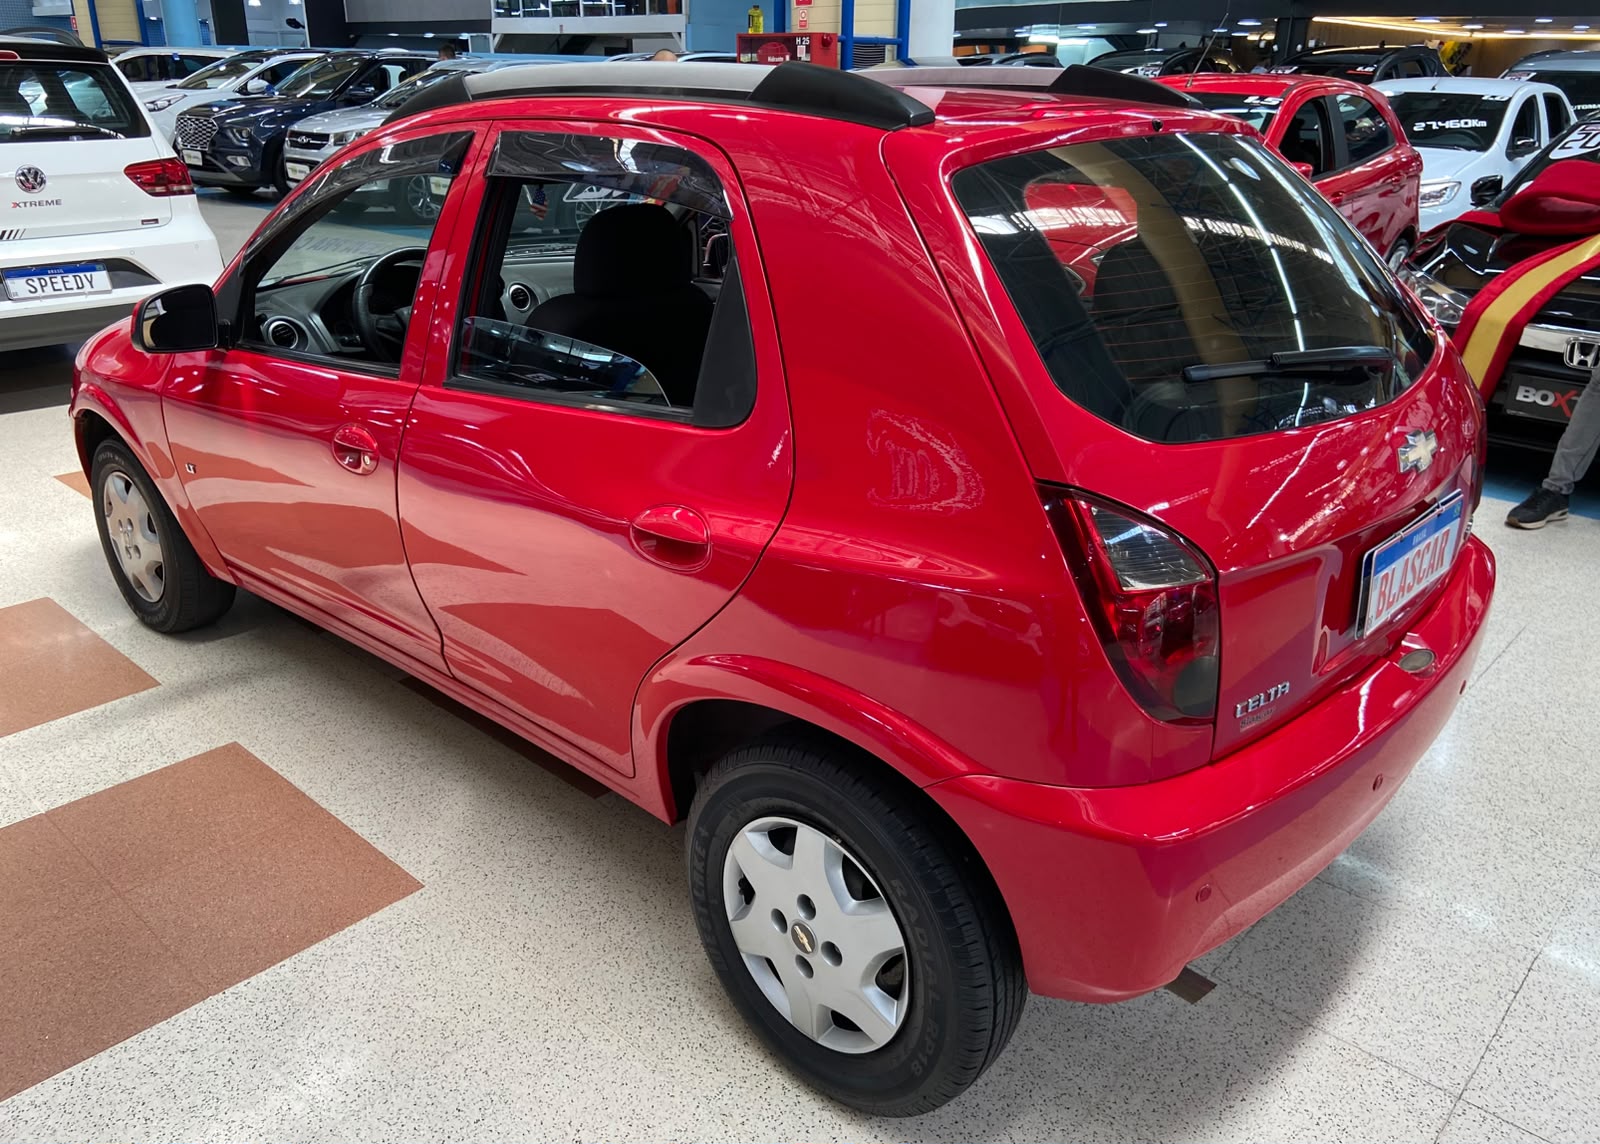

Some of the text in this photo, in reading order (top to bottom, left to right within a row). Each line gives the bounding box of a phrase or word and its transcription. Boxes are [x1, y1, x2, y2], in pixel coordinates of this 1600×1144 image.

[795, 37, 810, 45] H 25
[11, 199, 63, 209] XTREME
[25, 273, 95, 295] SPEEDY
[1516, 385, 1580, 418] BOX
[1375, 528, 1451, 621] BLASCAR
[1235, 681, 1290, 719] CELTA
[890, 878, 941, 1005] RADIAL
